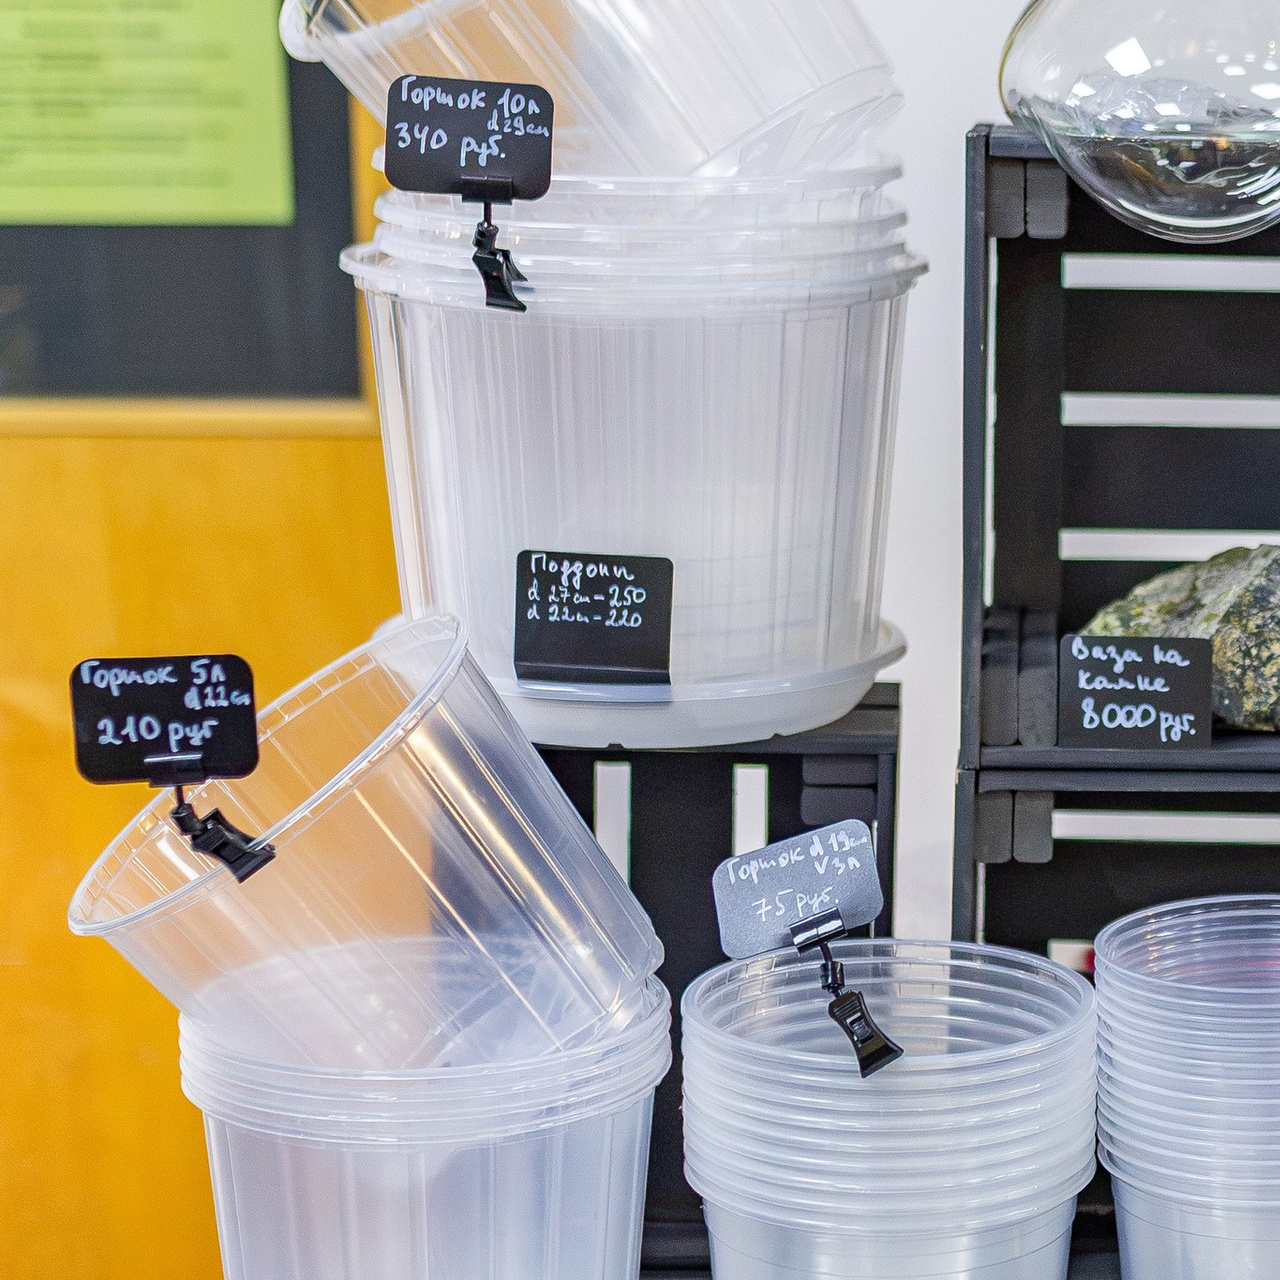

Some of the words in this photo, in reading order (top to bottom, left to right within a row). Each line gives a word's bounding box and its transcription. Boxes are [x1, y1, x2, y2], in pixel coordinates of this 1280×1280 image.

[401, 76, 486, 111] Горшок
[80, 660, 178, 697] Горшок
[726, 846, 805, 885] Горшок
